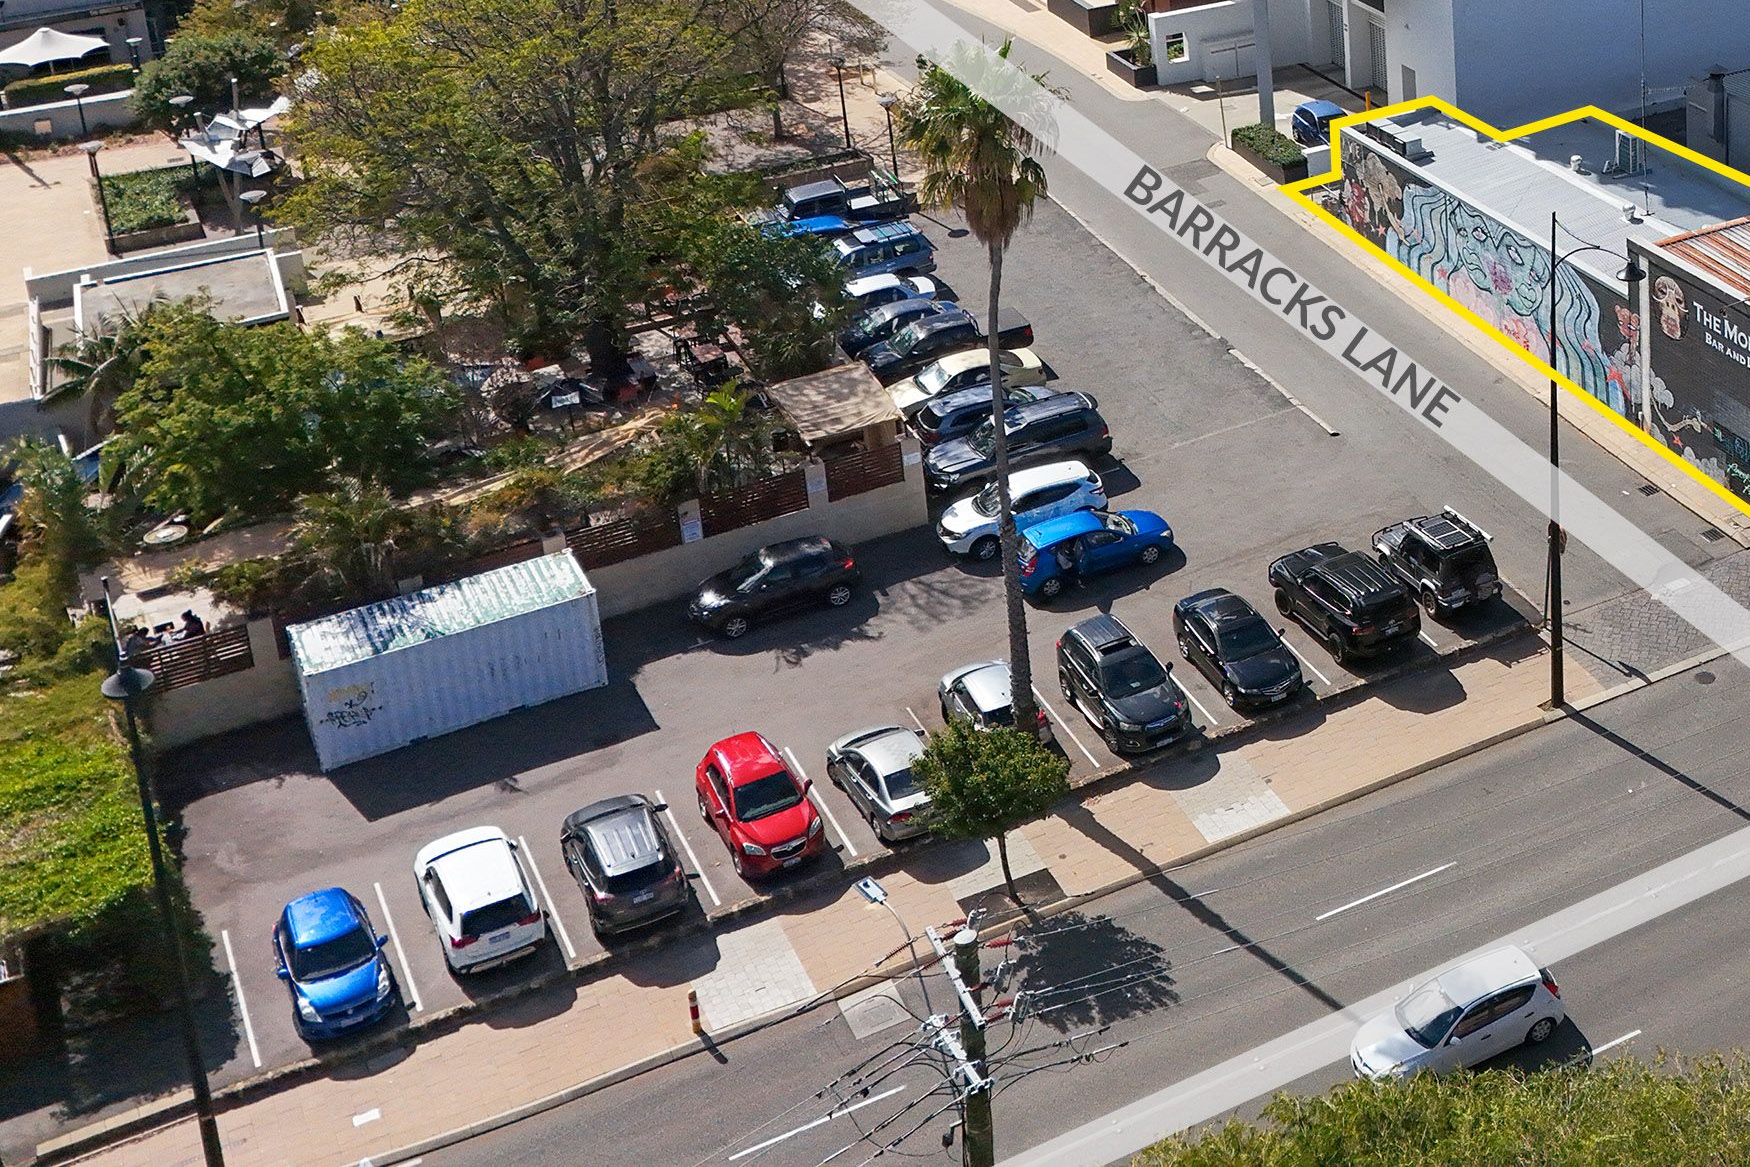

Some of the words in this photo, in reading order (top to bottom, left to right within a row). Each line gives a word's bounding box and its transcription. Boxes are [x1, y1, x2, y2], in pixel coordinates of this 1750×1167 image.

[1693, 300, 1722, 334] THE
[1705, 332, 1724, 352] BAR
[1725, 348, 1746, 365] AND
